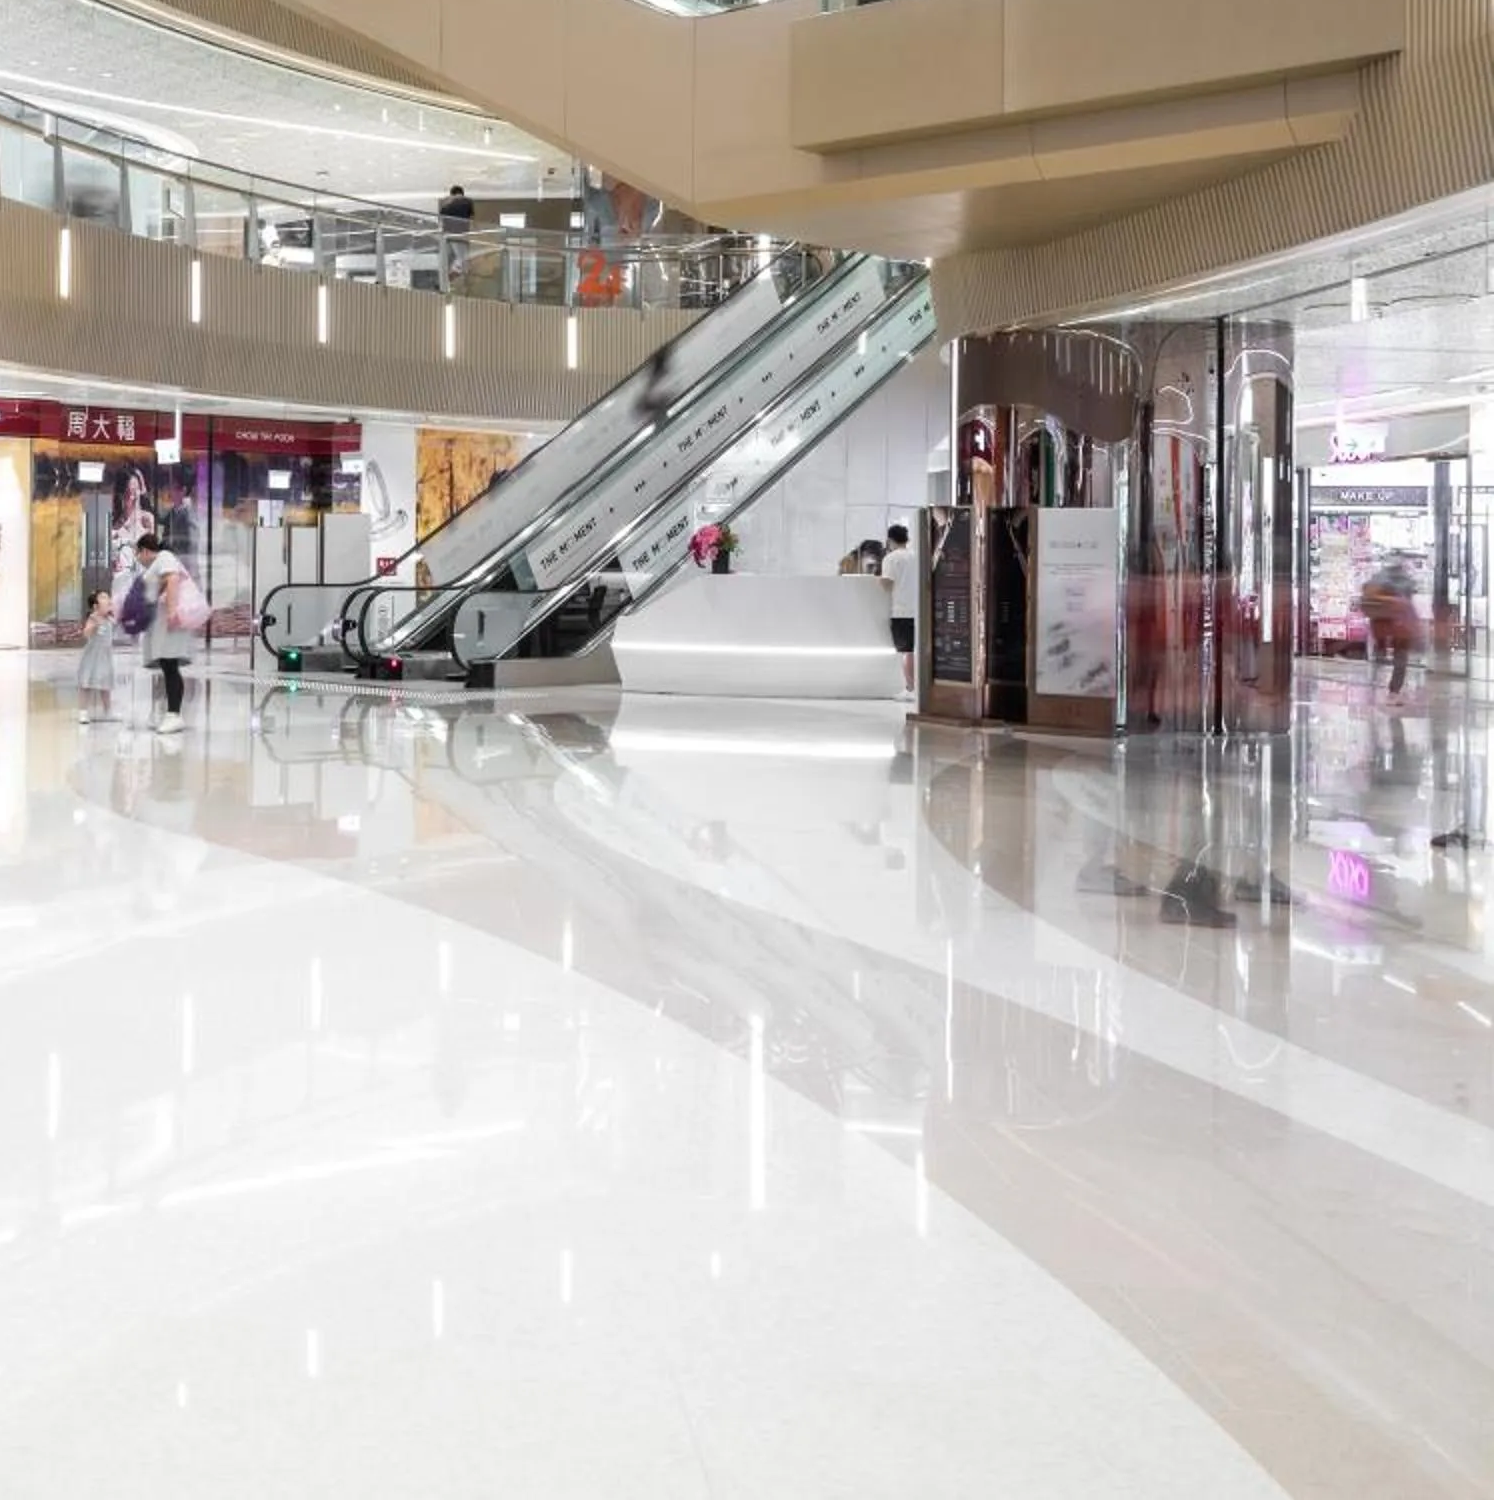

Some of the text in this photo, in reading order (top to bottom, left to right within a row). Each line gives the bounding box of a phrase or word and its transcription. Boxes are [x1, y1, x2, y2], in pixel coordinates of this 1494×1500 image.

[67, 411, 136, 441] 周大福
[631, 515, 690, 571] THE MMENT
[540, 552, 557, 570] THE
